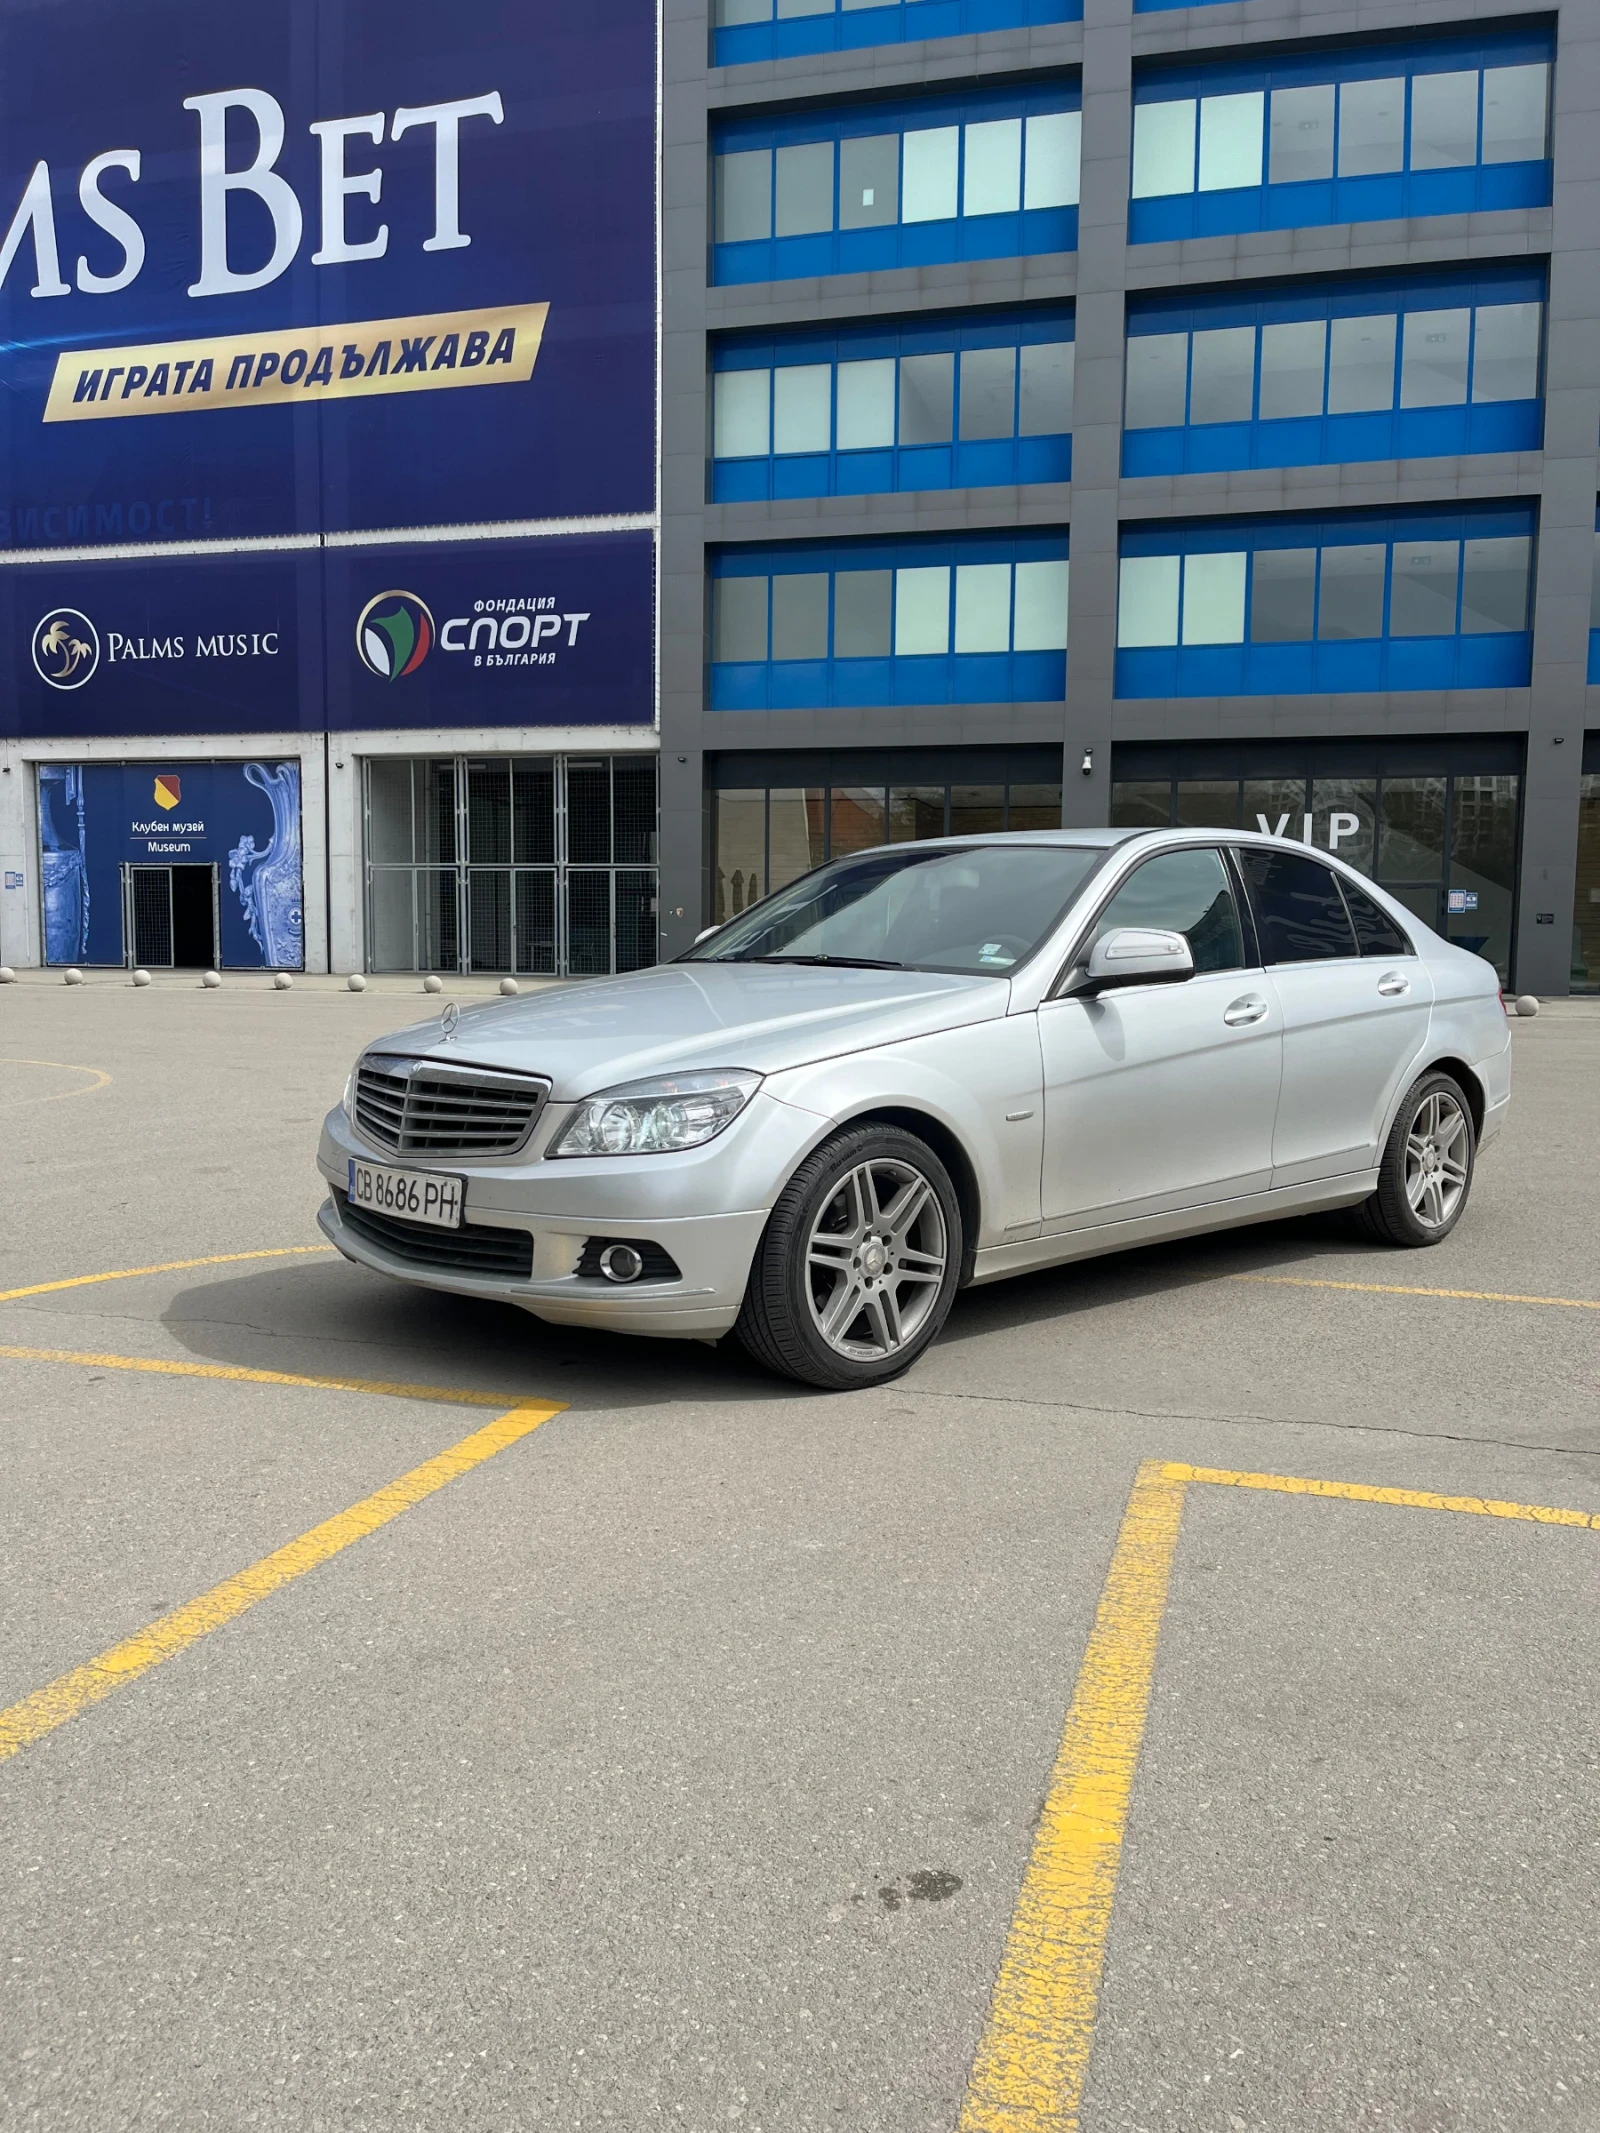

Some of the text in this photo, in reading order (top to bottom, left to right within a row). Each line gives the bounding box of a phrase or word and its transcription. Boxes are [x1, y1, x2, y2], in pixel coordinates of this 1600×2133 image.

[183, 88, 504, 298] BET
[72, 328, 516, 403] ИГРАТА ПРОДЪЛЖАВА
[474, 597, 556, 613] ФОНДАЦИЯ
[107, 632, 279, 662] PALMS MUSIC
[440, 612, 591, 651] СПОРТ
[474, 652, 556, 667] В БЪЛГАРИЯ
[131, 820, 205, 835] Клубен музей
[1256, 812, 1360, 850] VIP
[147, 841, 191, 852] Museum
[375, 1173, 420, 1213] 8686
